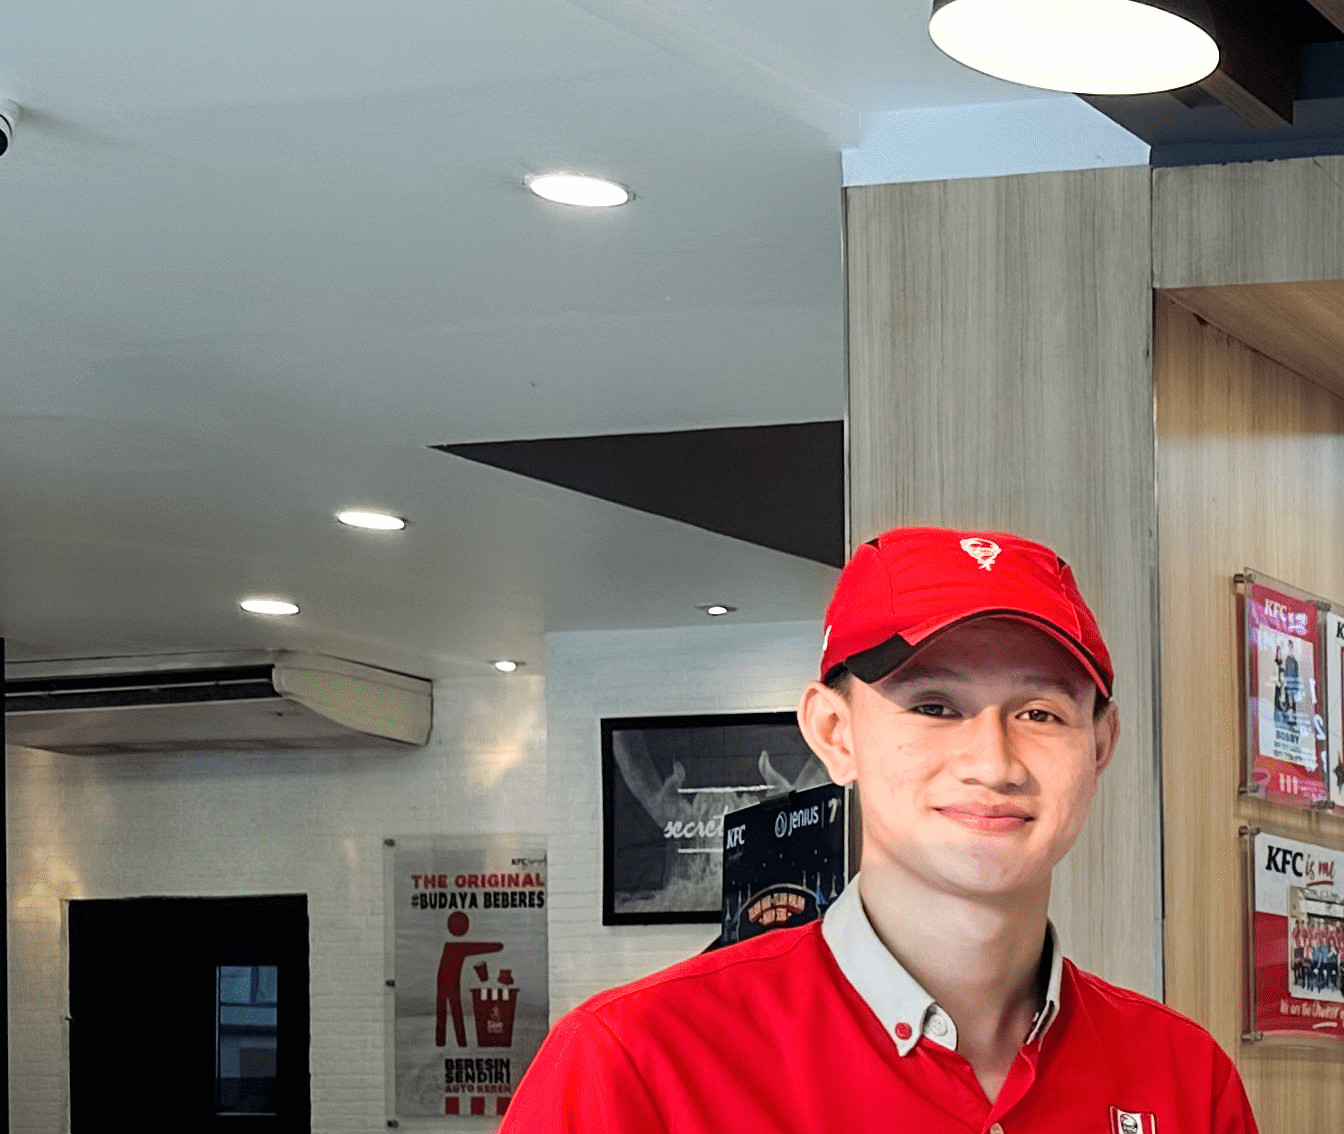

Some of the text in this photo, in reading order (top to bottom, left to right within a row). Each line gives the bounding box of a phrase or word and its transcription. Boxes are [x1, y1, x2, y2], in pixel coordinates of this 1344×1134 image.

[1264, 598, 1287, 622] KFC
[726, 824, 746, 849] KFC
[1265, 845, 1335, 880] KFC is me
[411, 873, 545, 888] THE ORIGINAL
[411, 891, 545, 909] #BUDAYA BEBERES
[445, 1058, 510, 1071] BERESIN
[445, 1071, 510, 1083] SENDIRI
